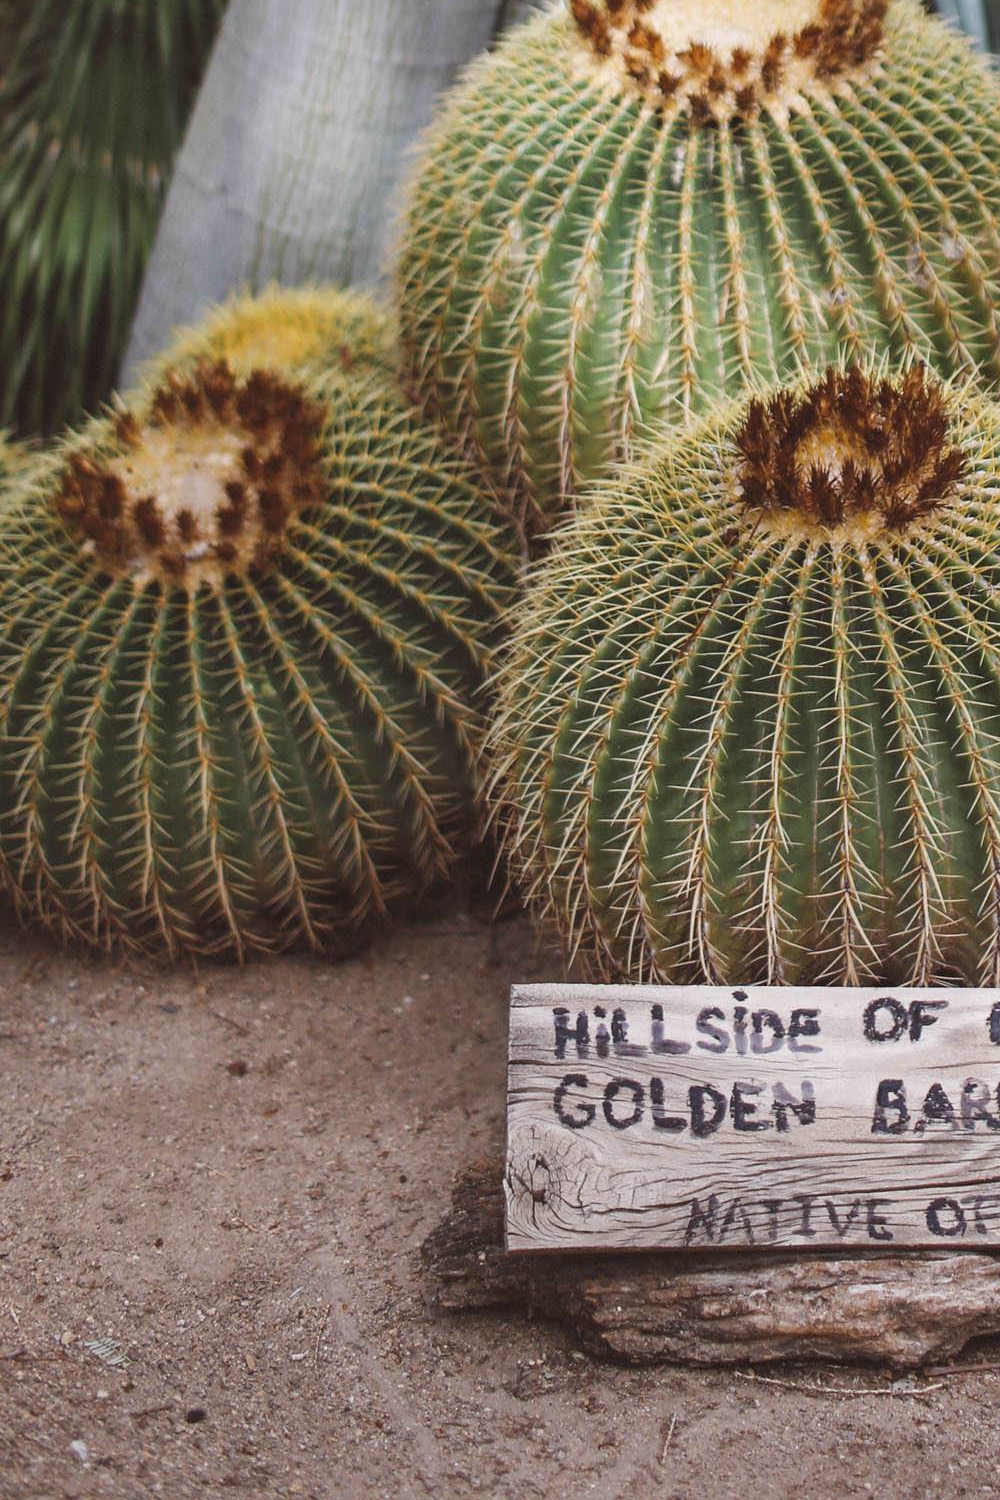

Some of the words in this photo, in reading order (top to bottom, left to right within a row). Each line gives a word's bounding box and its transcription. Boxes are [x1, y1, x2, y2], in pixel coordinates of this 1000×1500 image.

[863, 996, 949, 1044] OF
[552, 1073, 817, 1138] GOLDEN
[684, 1197, 894, 1246] NATIVE
[925, 1194, 1000, 1238] OF
